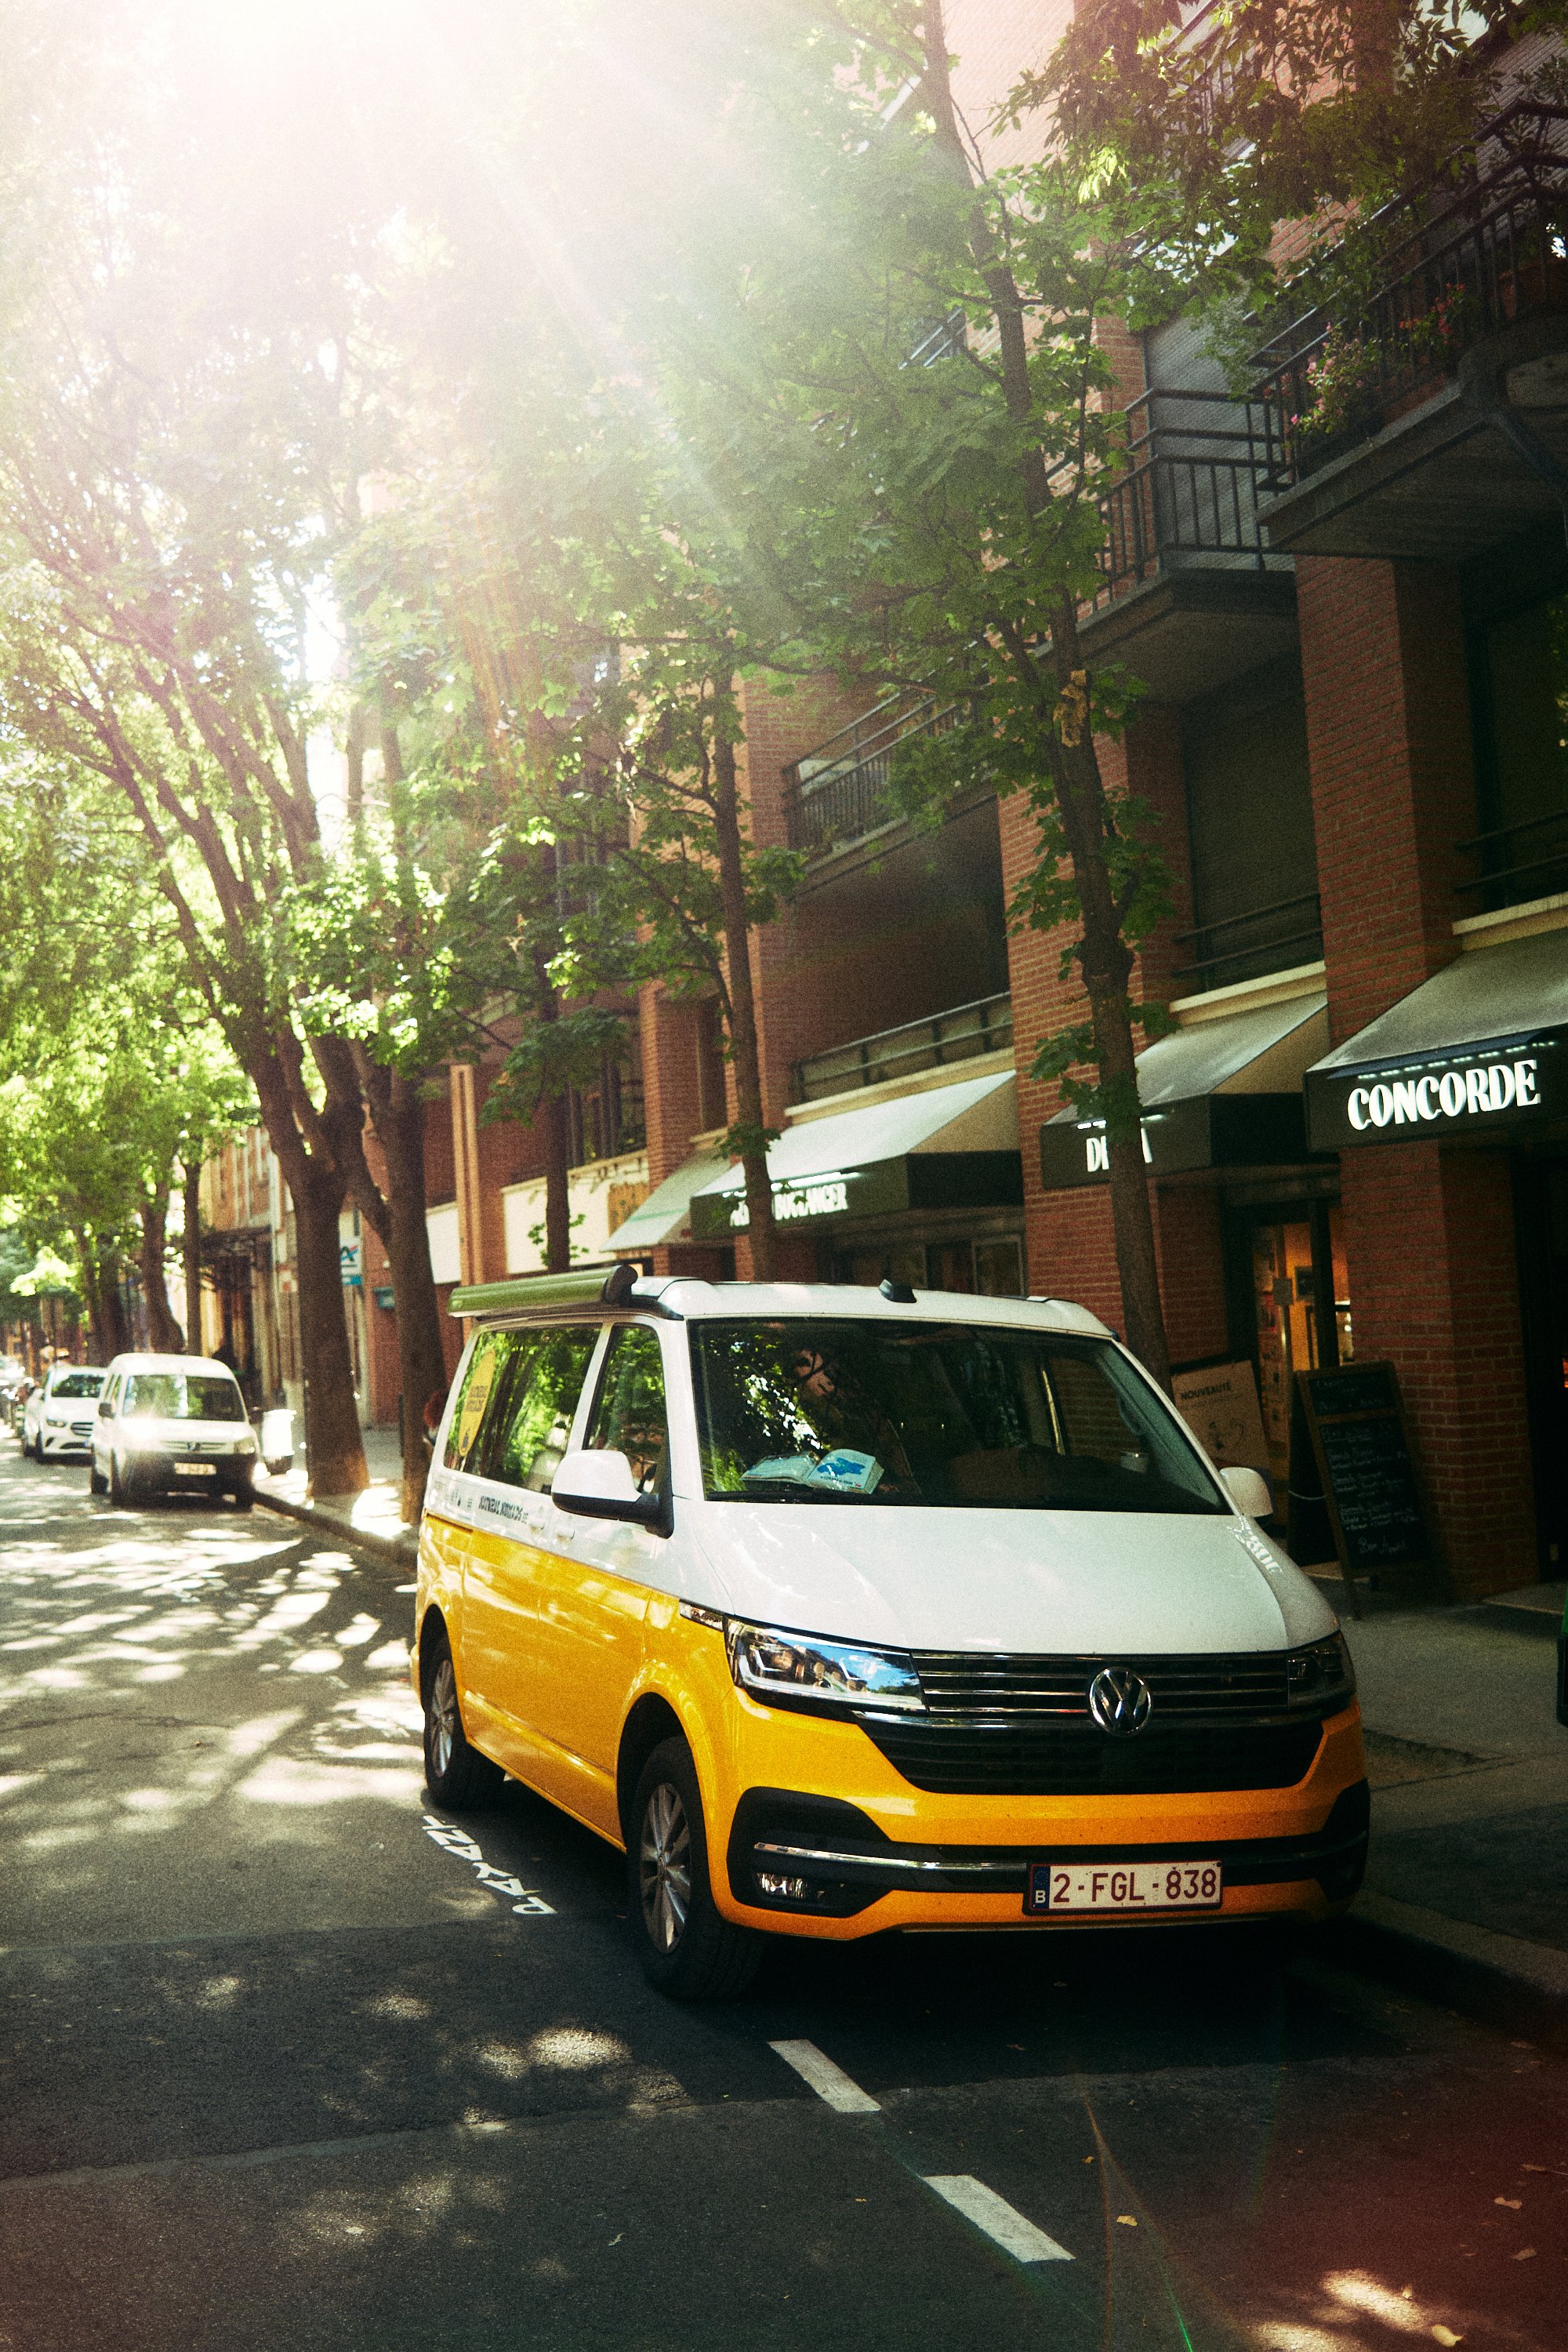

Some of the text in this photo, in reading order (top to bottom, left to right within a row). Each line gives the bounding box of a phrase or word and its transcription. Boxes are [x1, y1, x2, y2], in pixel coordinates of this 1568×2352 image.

[1347, 1059, 1541, 1131] CONCORDE
[422, 1815, 558, 1915] PAYANT
[1035, 1868, 1217, 1904] B 2-FGL-838
